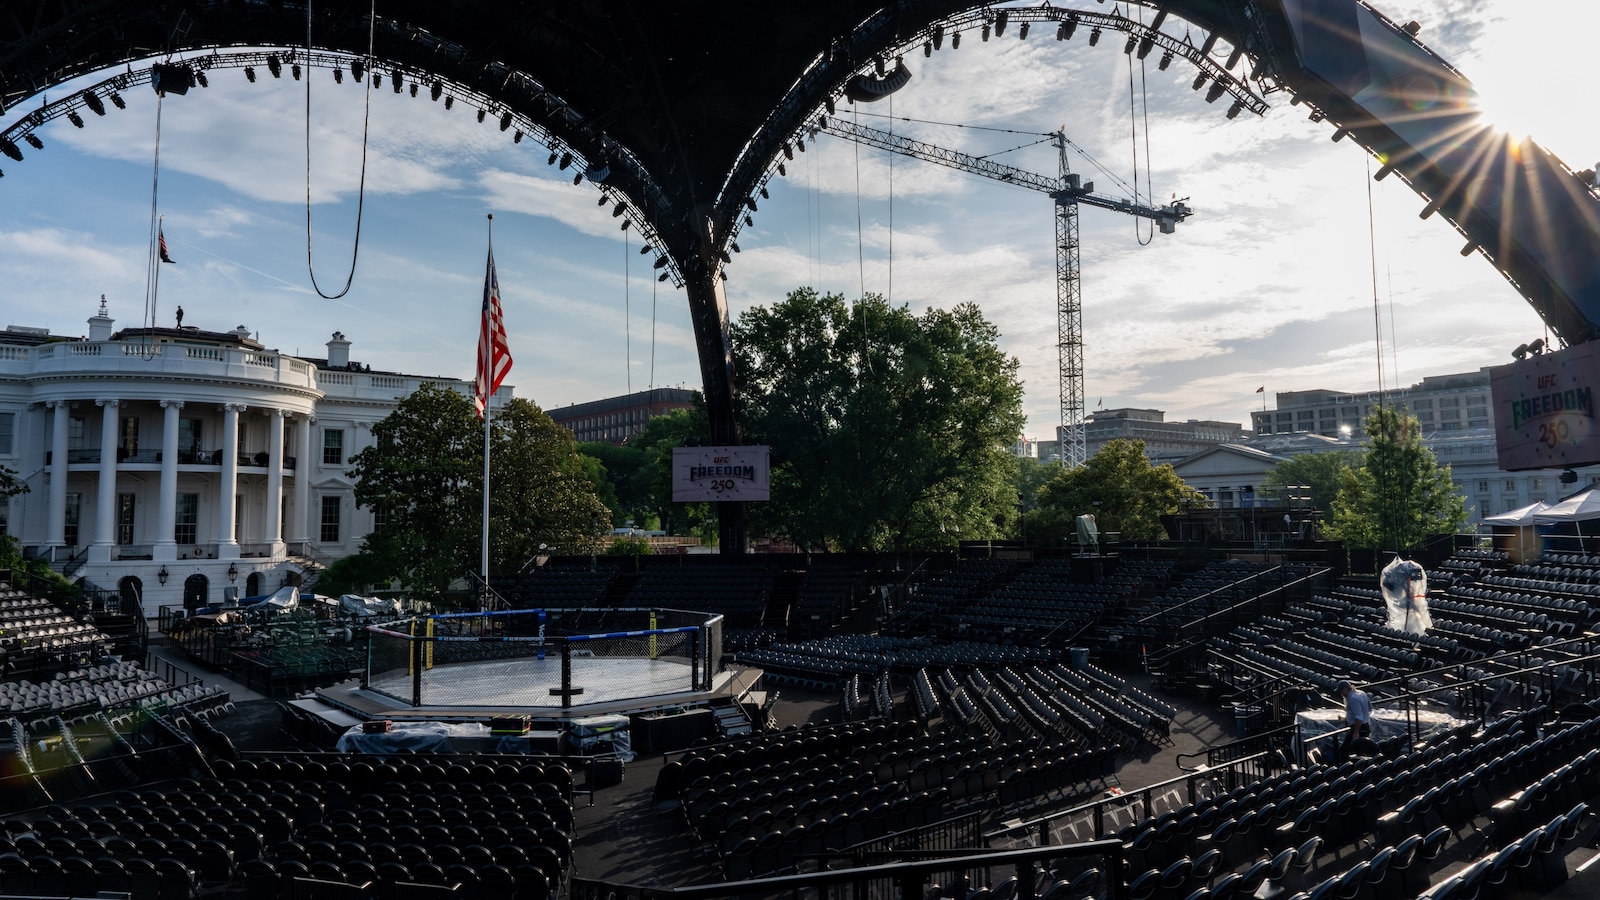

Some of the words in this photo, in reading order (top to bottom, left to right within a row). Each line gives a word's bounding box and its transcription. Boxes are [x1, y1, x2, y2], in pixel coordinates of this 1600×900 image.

[1538, 374, 1557, 389] UFC
[1512, 386, 1594, 431] FREEDOM
[1539, 420, 1569, 449] 250
[690, 466, 754, 482] FREEDOM
[710, 480, 735, 493] 250
